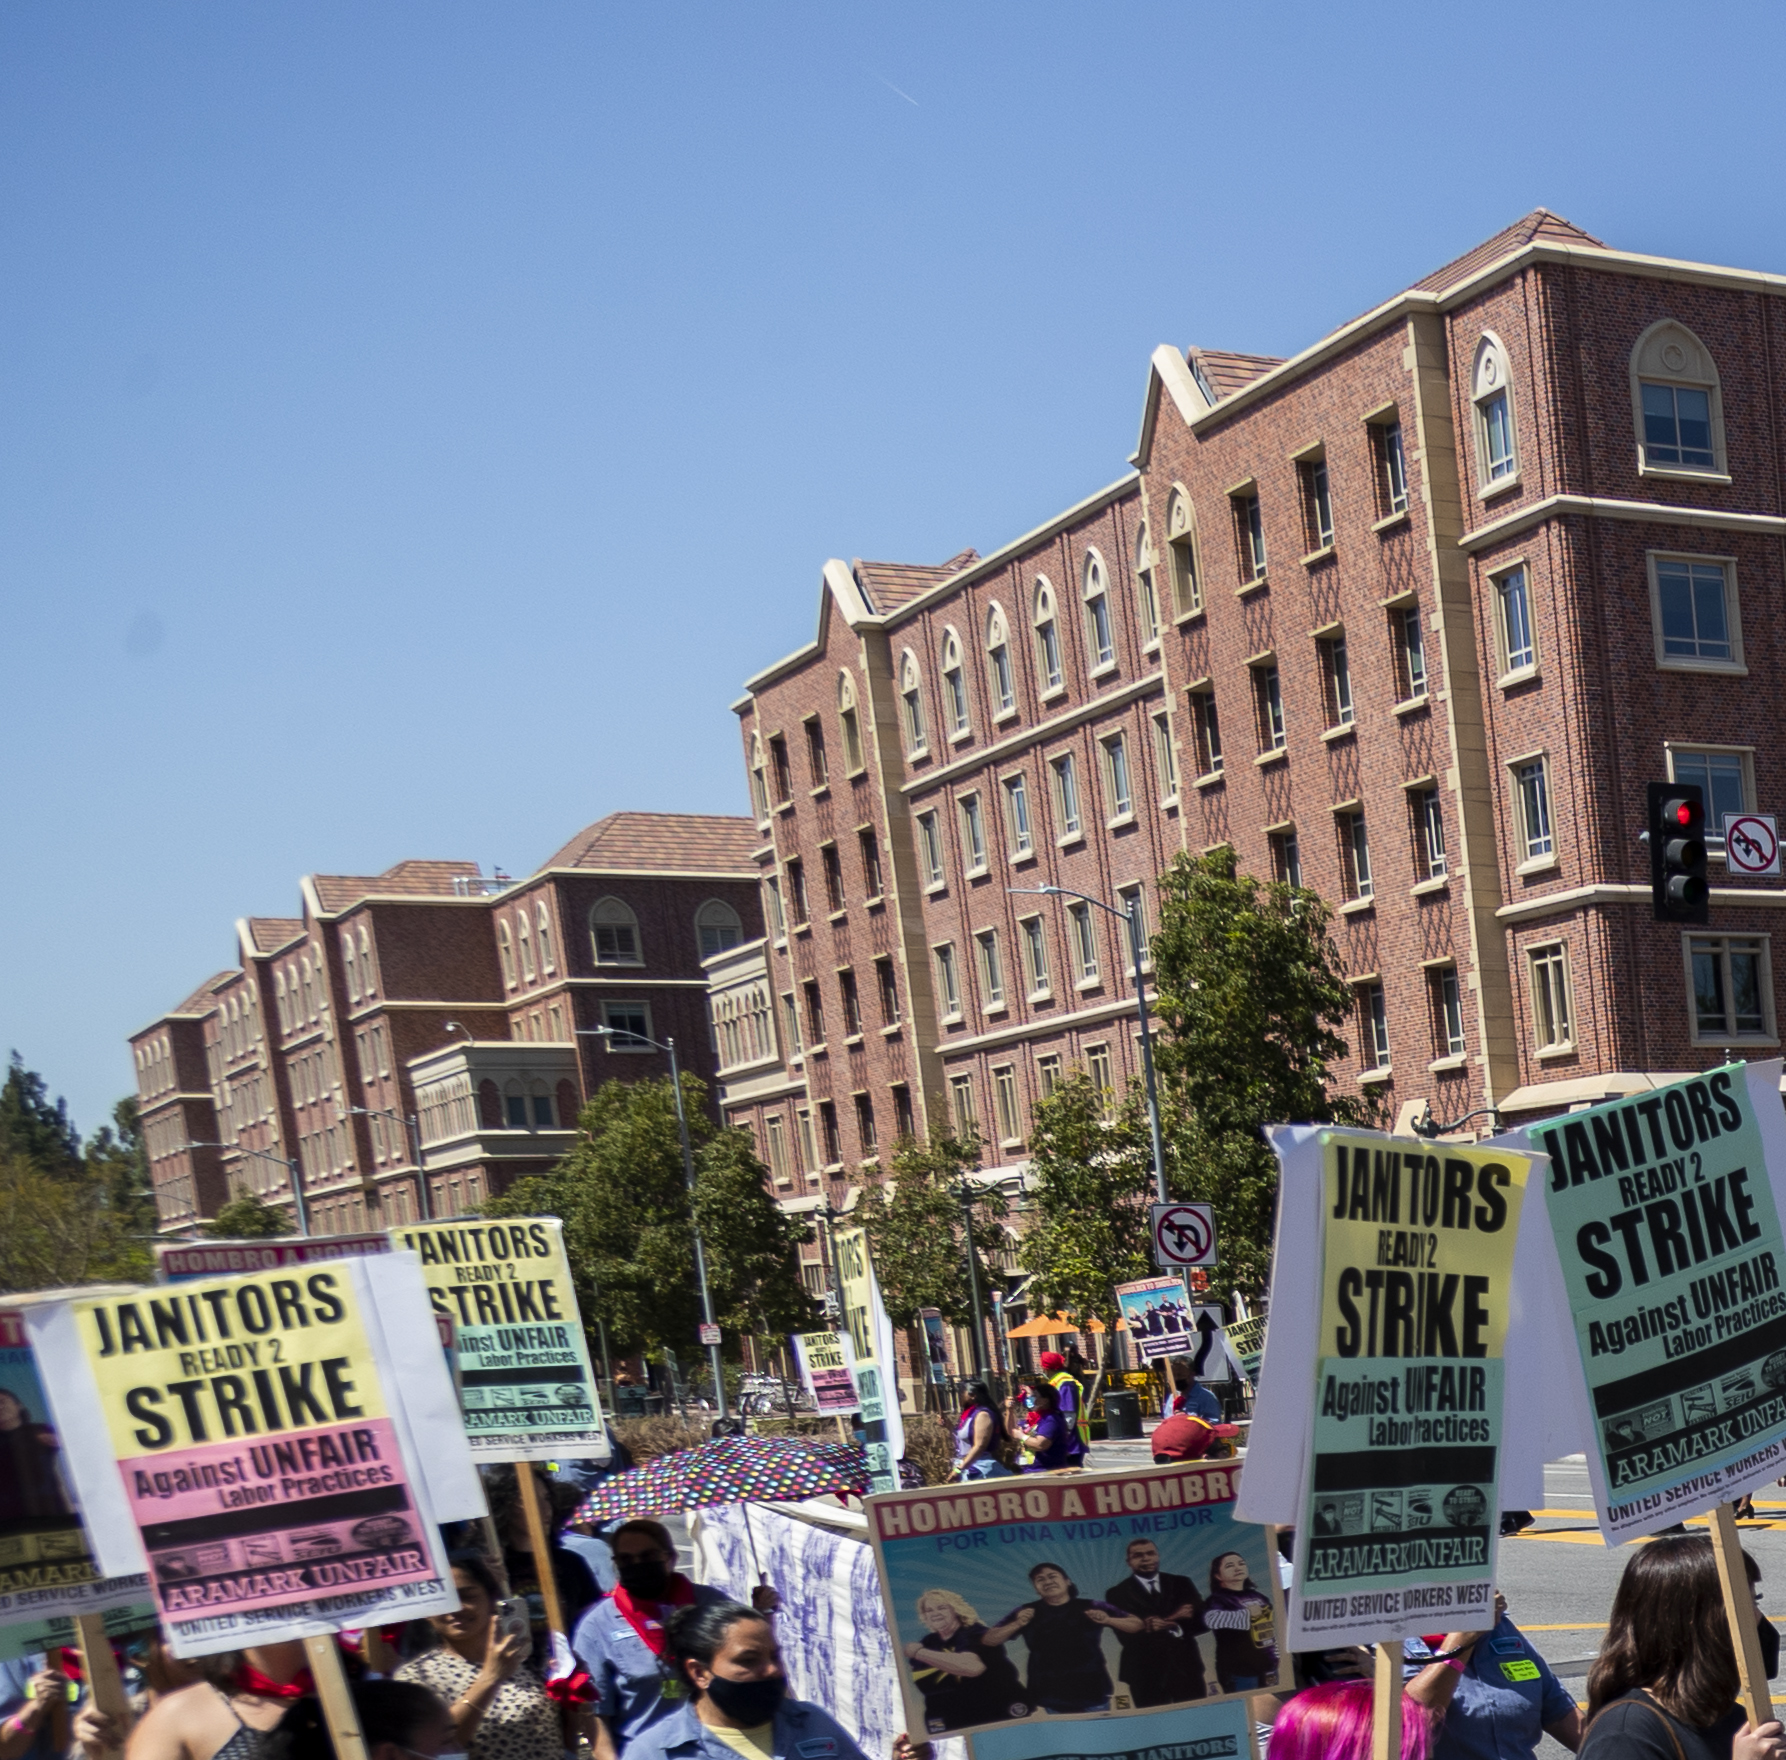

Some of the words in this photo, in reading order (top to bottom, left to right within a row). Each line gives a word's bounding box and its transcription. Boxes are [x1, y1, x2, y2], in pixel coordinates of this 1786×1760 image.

[1543, 1072, 1742, 1193] JANITORS
[1333, 1145, 1511, 1233] JANITORS
[1618, 1156, 1688, 1208] READY
[1690, 1151, 1706, 1184] 2
[1377, 1230, 1426, 1267] READY
[1427, 1233, 1438, 1268] 2
[1576, 1166, 1762, 1299] STRIKE
[167, 1249, 278, 1274] HOMBRO
[278, 1247, 299, 1266] A
[455, 1265, 502, 1283] READY
[508, 1263, 518, 1280] 2
[93, 1273, 347, 1358] JANITORS
[428, 1279, 564, 1327] STRIKE
[1336, 1266, 1489, 1358] STRIKE
[1589, 1296, 1692, 1357] Against
[1690, 1251, 1780, 1319] UNFAIR
[461, 1333, 495, 1355] inst
[497, 1325, 571, 1352] UNFAIR
[804, 1331, 841, 1349] JANITORS
[1228, 1315, 1269, 1337] JANITOR
[1236, 1333, 1267, 1355] STRI
[1662, 1327, 1713, 1359] Labor
[179, 1341, 261, 1378] READY
[267, 1338, 287, 1365] 2
[479, 1352, 514, 1368] Labor
[516, 1350, 578, 1368] Practices
[809, 1350, 844, 1369] STRIKE
[125, 1356, 364, 1451] STRIKE
[1322, 1375, 1400, 1422] Against
[1405, 1366, 1486, 1414] UNFAIR
[1726, 1389, 1757, 1411] SEIU
[532, 1408, 595, 1425] UNFAIR
[1369, 1416, 1413, 1446] Labor
[1644, 1409, 1669, 1425] NOT
[133, 1456, 249, 1500] Against
[248, 1428, 382, 1480] UNFAIR
[1615, 1421, 1734, 1485] ARAMARK
[217, 1482, 277, 1510] Labor
[280, 1463, 394, 1500] Practices
[1607, 1494, 1662, 1523] UNITED
[1665, 1471, 1722, 1503] SERVICE
[1725, 1444, 1780, 1478] WORKERS
[881, 1488, 1051, 1537] HOMBRO
[1062, 1488, 1086, 1517] A
[936, 1531, 988, 1554] POR
[999, 1524, 1055, 1546] UNA
[1064, 1517, 1122, 1541] VIDA
[1131, 1508, 1214, 1536] MEJOR
[164, 1567, 308, 1610] ARAMARK
[312, 1549, 427, 1587] UNFAIR
[1309, 1541, 1410, 1579] ARAMARK
[1410, 1536, 1485, 1569] UNFAIR
[26, 1585, 88, 1610] SERVICE
[93, 1574, 149, 1595] WORKE
[178, 1613, 240, 1637] UNITED
[244, 1600, 312, 1626] SERVICE
[316, 1586, 398, 1615] WORKERS
[402, 1577, 447, 1599] WEST
[1303, 1598, 1347, 1622] UNITED
[1350, 1592, 1400, 1617] SERVICE
[1403, 1585, 1452, 1612] WORKERS
[1457, 1583, 1489, 1605] WEST
